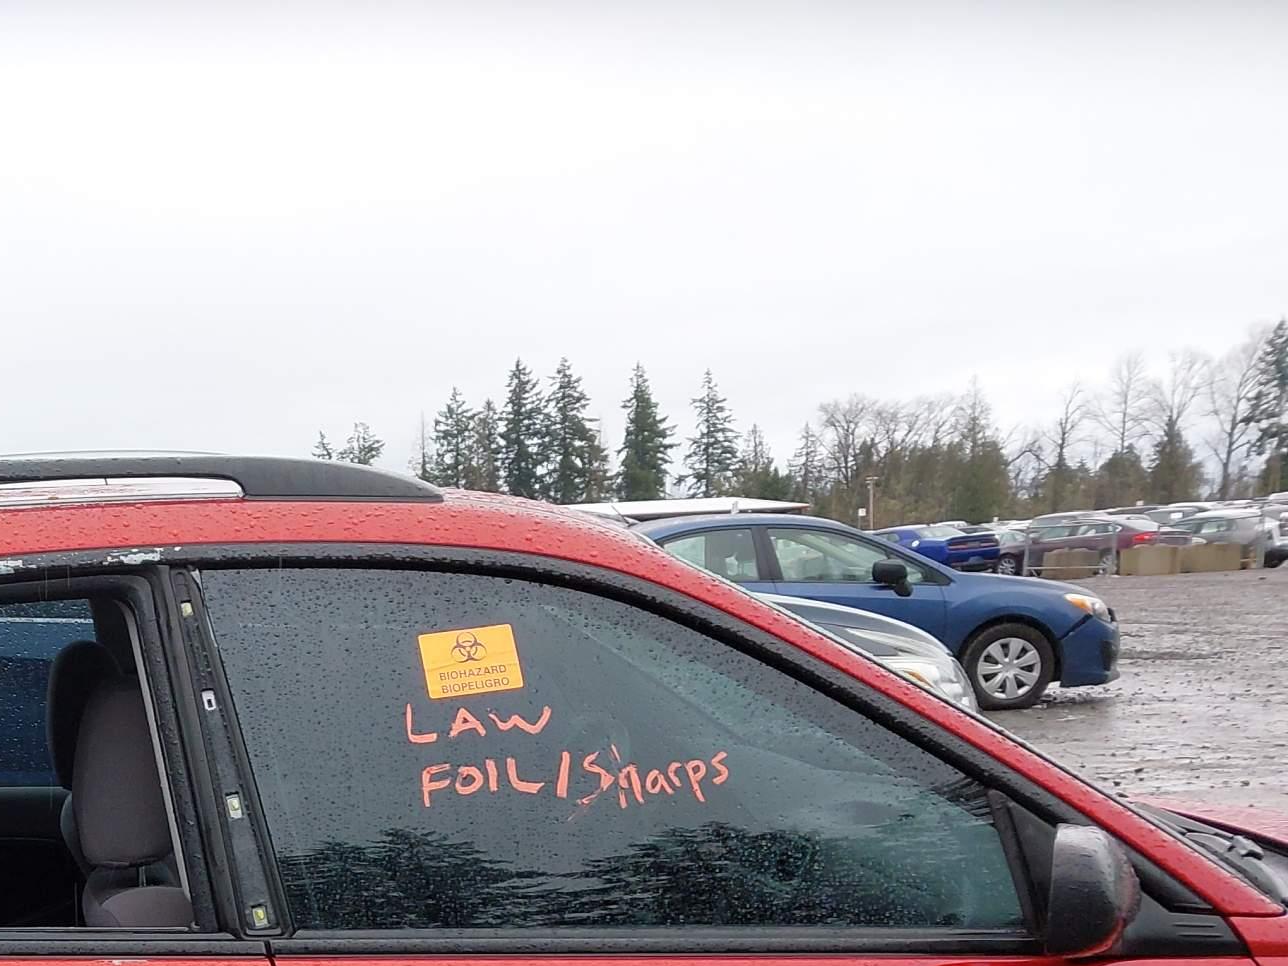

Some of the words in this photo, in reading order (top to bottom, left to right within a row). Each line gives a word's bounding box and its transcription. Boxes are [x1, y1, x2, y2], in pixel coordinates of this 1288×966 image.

[439, 664, 507, 681] BIOHAZARD
[441, 676, 510, 694] BIOPELIGRO
[406, 703, 552, 744] LAW
